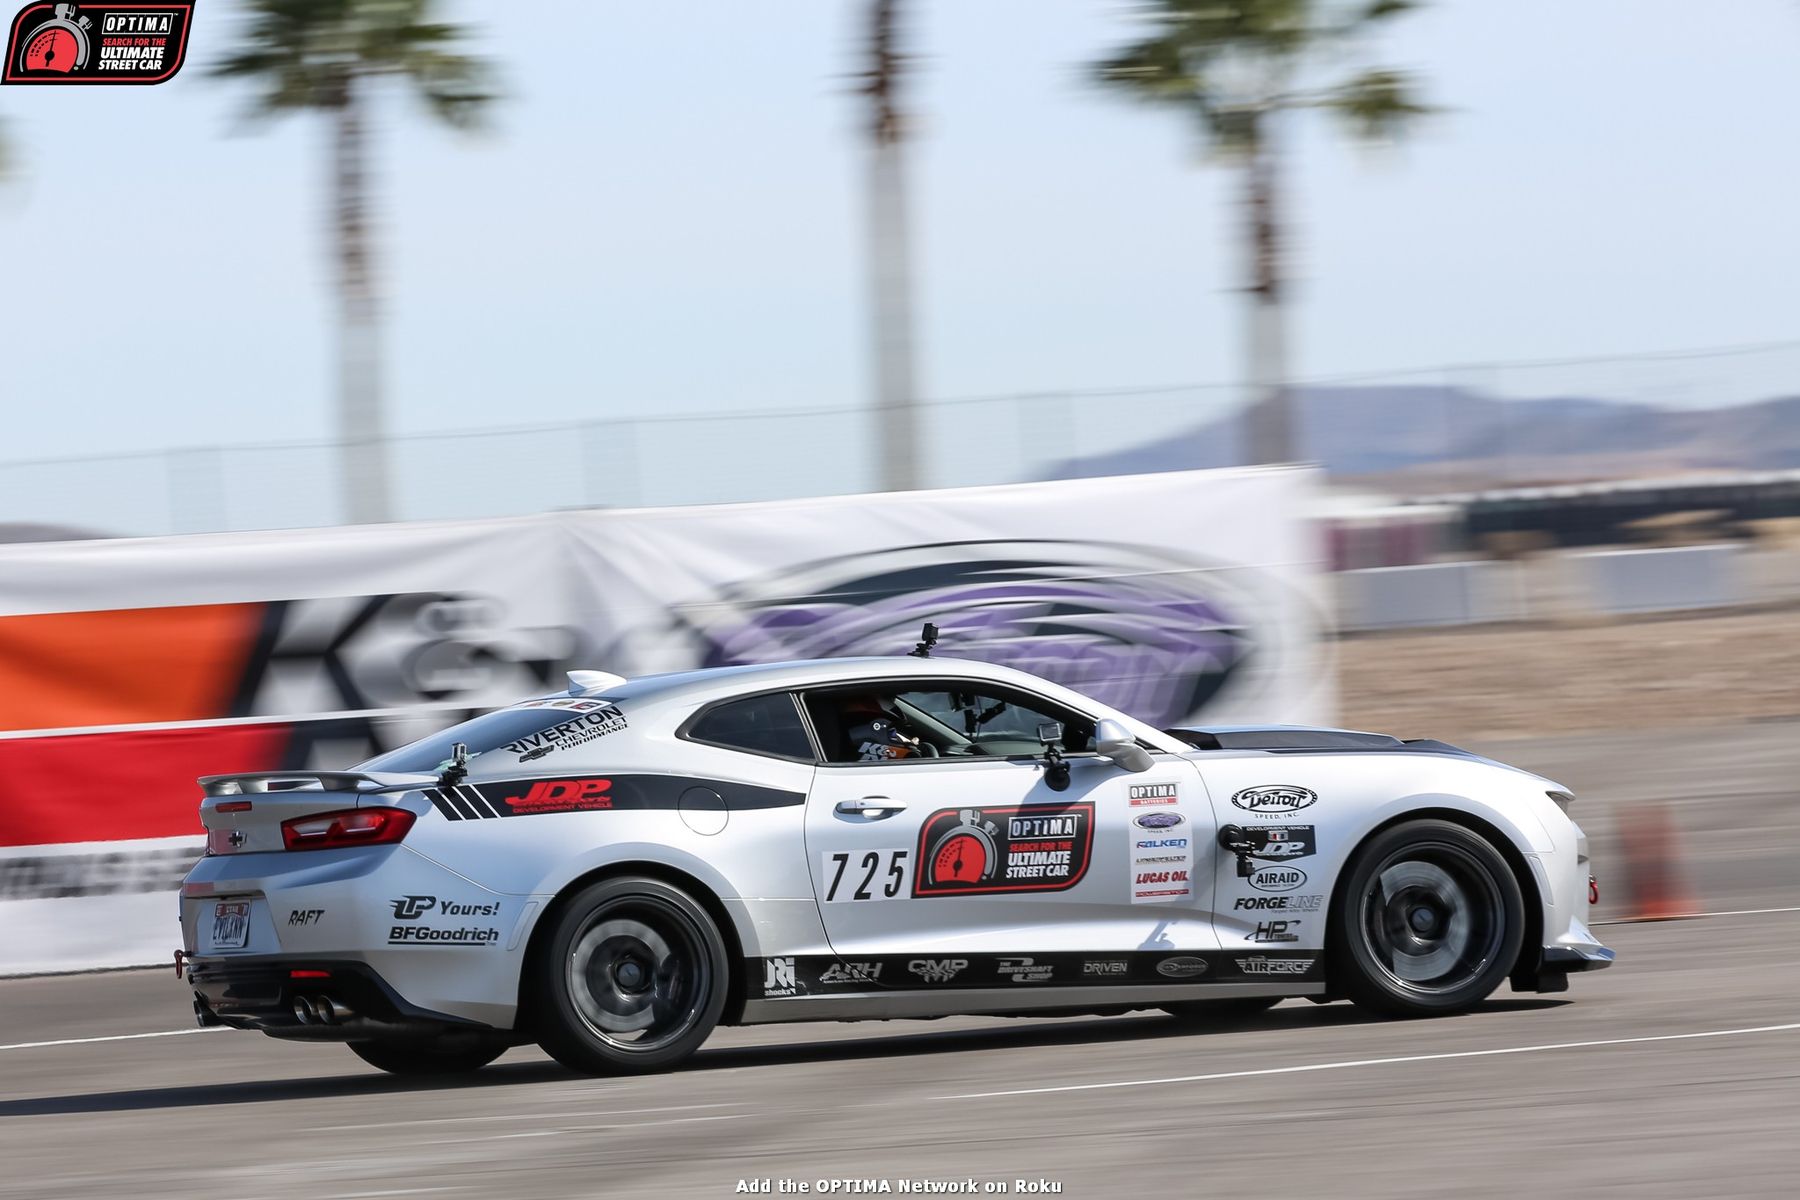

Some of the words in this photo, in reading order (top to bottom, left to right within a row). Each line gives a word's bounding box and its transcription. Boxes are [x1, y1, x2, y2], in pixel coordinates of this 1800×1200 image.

[500, 706, 624, 754] RIVERTON
[555, 715, 627, 747] CHEVROLET
[505, 779, 612, 805] JDP
[1131, 785, 1175, 798] OPTIMA
[1012, 818, 1073, 836] OPTIMA
[1136, 839, 1187, 848] FALKEN
[1252, 841, 1305, 856] JDP
[1007, 851, 1071, 866] ULTIMATE
[826, 851, 907, 901] 725
[1006, 865, 1046, 878] STREET
[1046, 865, 1069, 877] CAR
[1136, 872, 1170, 884] LUCAS
[1171, 870, 1189, 881] OIL
[1255, 872, 1299, 884] AIRAID
[440, 901, 500, 916] Yours!
[1233, 895, 1323, 910] FORGELINE
[288, 910, 325, 927] RAFT
[389, 926, 499, 941] BFGoodrich
[1083, 963, 1127, 975] DRIVEN
[765, 988, 790, 996] shocks
